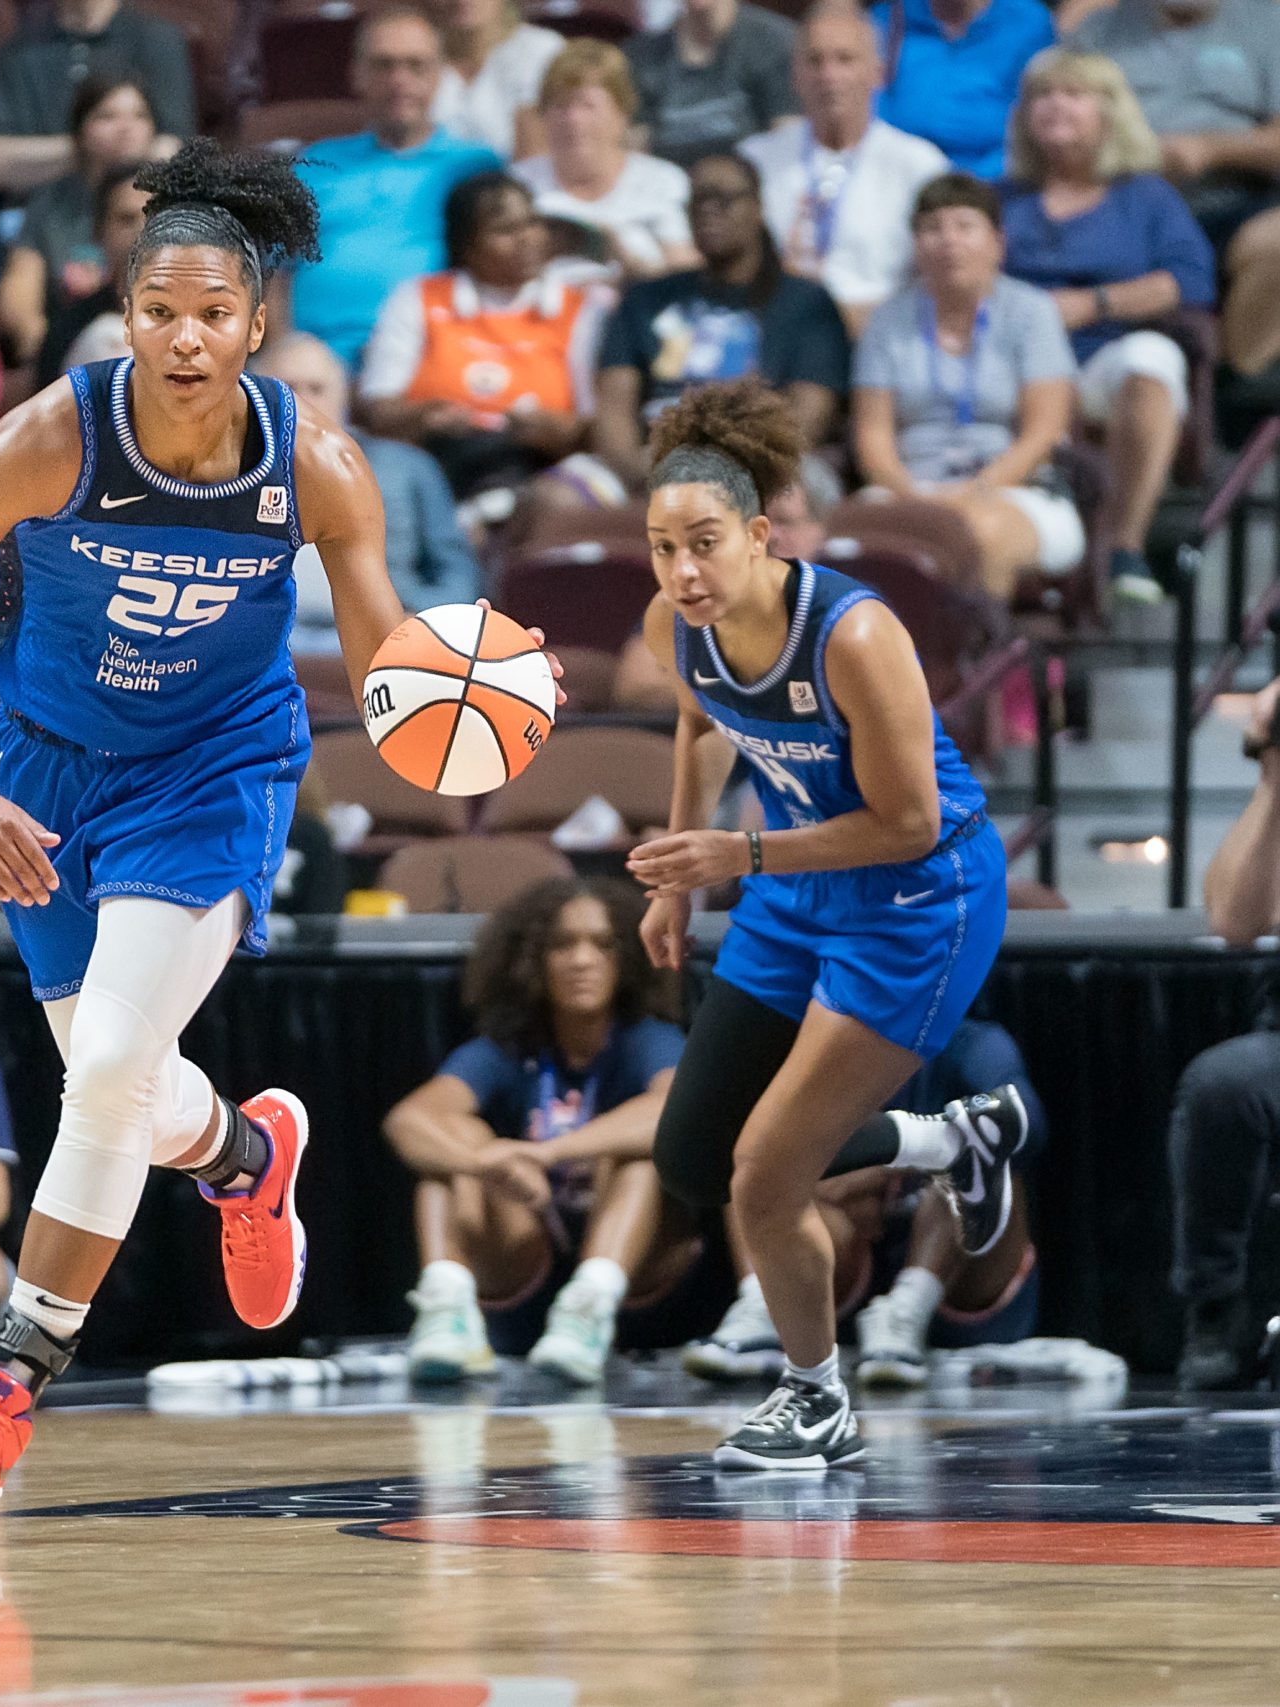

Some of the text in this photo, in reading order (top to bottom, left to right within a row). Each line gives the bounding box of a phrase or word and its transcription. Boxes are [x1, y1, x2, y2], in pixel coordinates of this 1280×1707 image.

[260, 504, 284, 516] Post
[70, 534, 286, 579] KEESUSK
[106, 574, 239, 637] 25
[107, 632, 140, 658] Yale
[100, 649, 197, 676] NewHaven
[95, 664, 160, 692] Health
